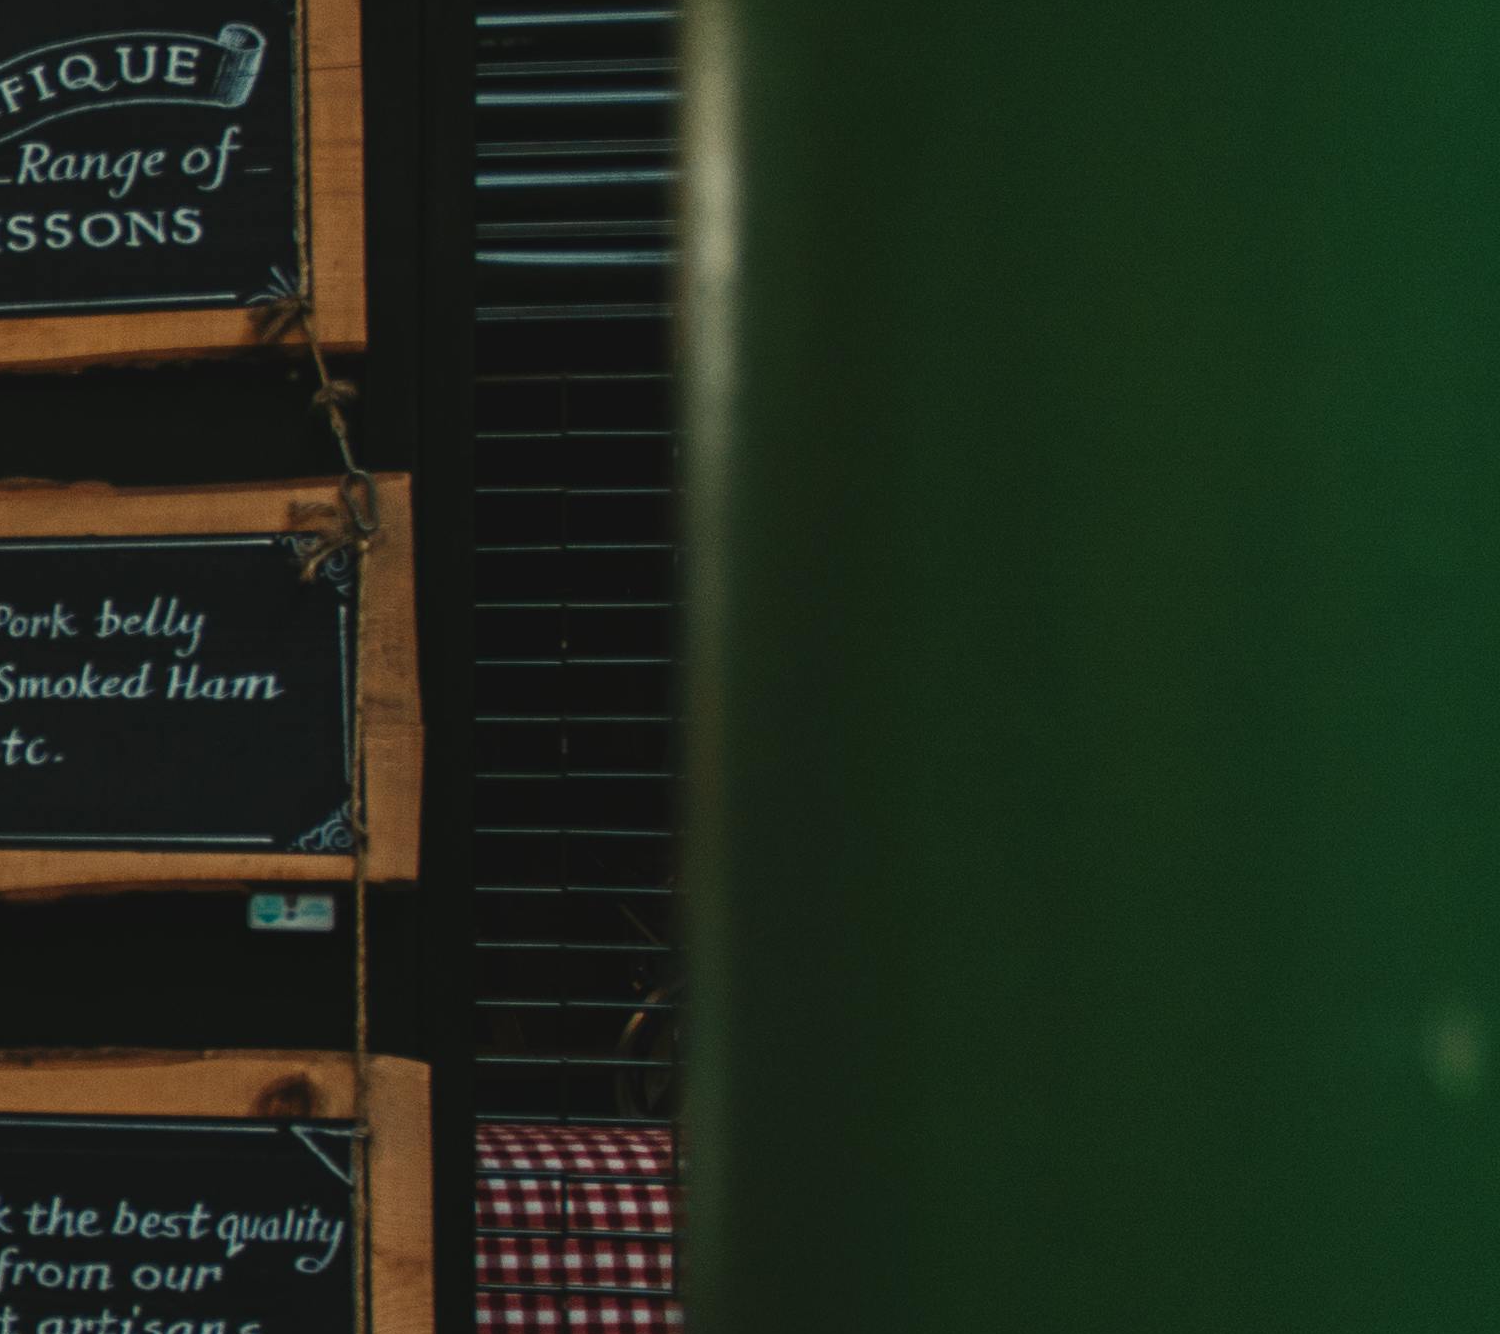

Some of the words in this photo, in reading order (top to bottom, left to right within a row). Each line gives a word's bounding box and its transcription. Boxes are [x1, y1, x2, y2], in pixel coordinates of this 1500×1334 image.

[17, 142, 166, 198] Range
[180, 125, 244, 192] of
[100, 598, 206, 657] belly
[167, 665, 285, 700] Ham
[23, 1197, 98, 1239] the
[112, 1200, 211, 1241] best
[217, 1205, 343, 1272] quality
[131, 1261, 223, 1293] our
